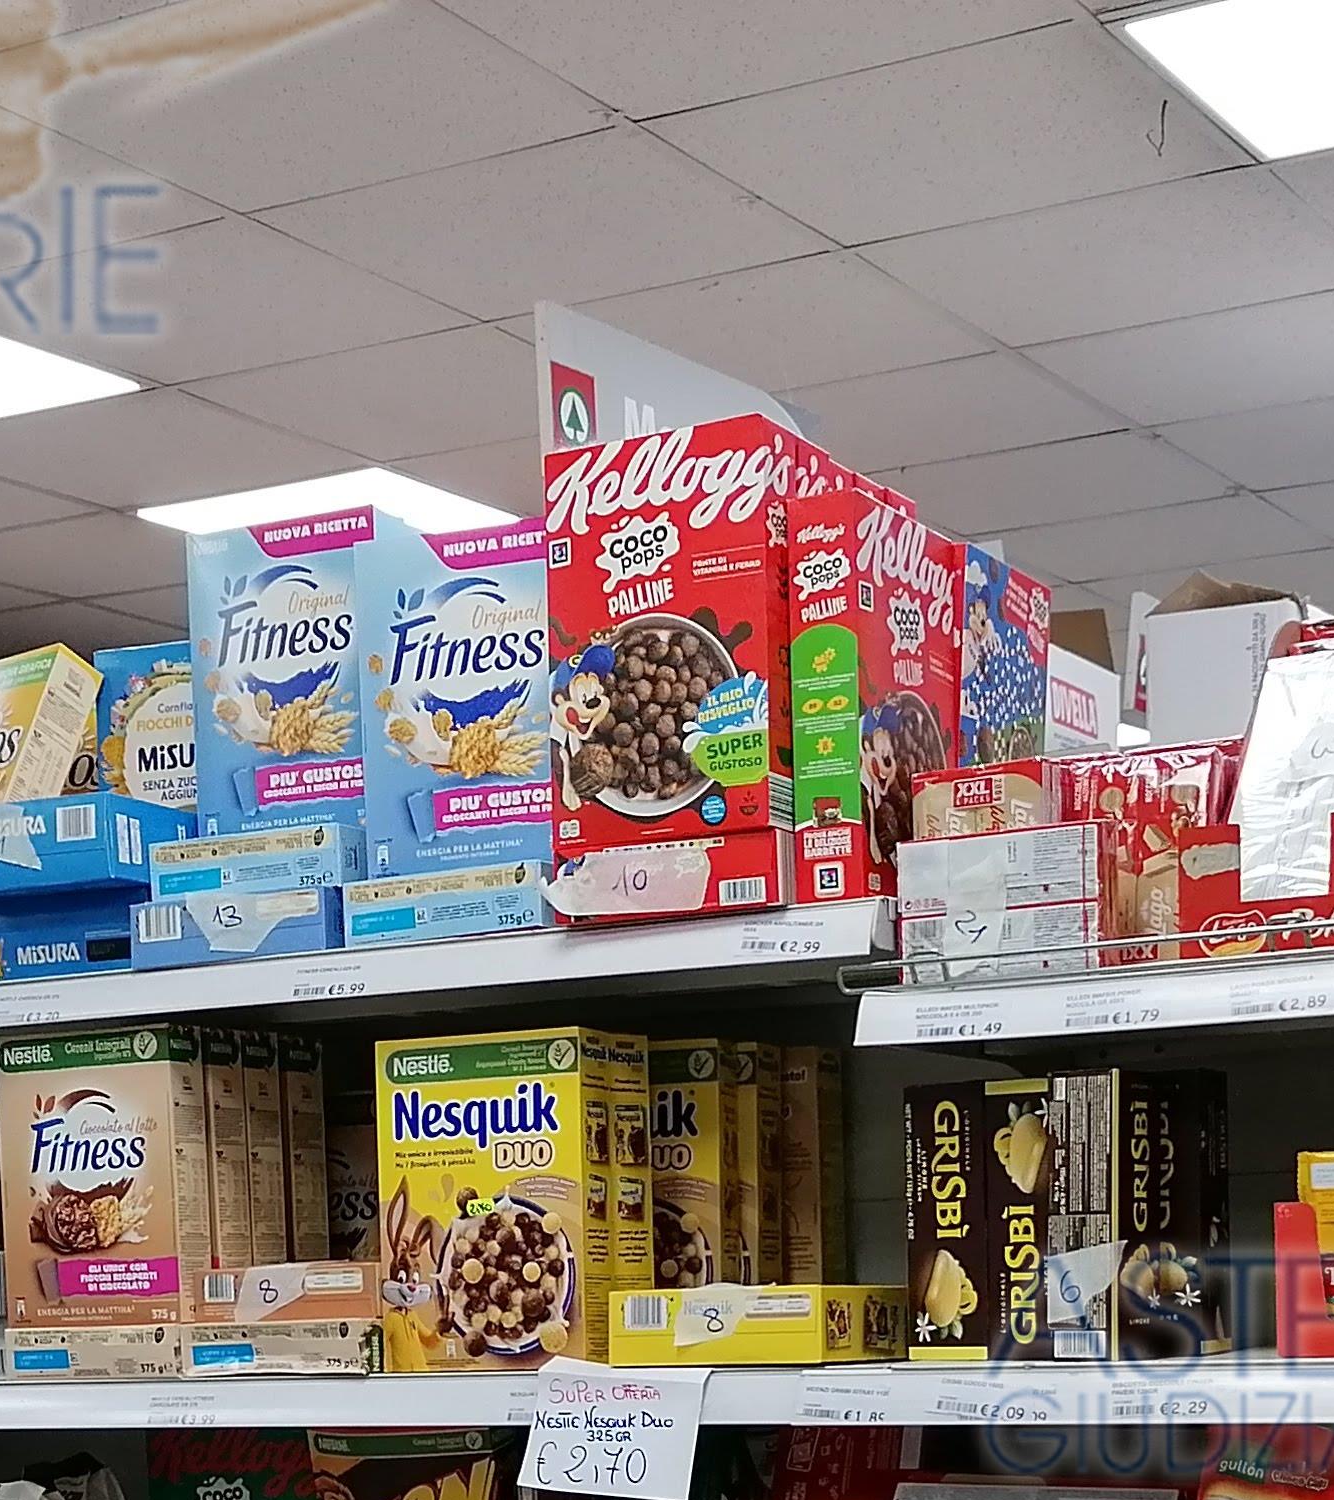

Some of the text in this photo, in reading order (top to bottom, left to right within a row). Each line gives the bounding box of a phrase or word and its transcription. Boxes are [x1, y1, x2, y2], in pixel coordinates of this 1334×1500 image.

[546, 421, 792, 535] Kellogg's
[265, 517, 368, 543] NUOVA RICETTA
[289, 591, 349, 615] Original
[608, 578, 675, 618] PALLINE
[217, 601, 354, 669] Fitness
[389, 615, 545, 686] Fitness
[707, 733, 762, 759] SUPER
[709, 756, 762, 771] GUSTOSO
[213, 903, 242, 928] 13
[393, 1052, 454, 1076] Nestlé
[393, 1082, 559, 1150] Nesquik
[30, 1117, 146, 1174] Fitness
[494, 1140, 553, 1169] DUO
[1218, 1458, 1264, 1482] gullón
